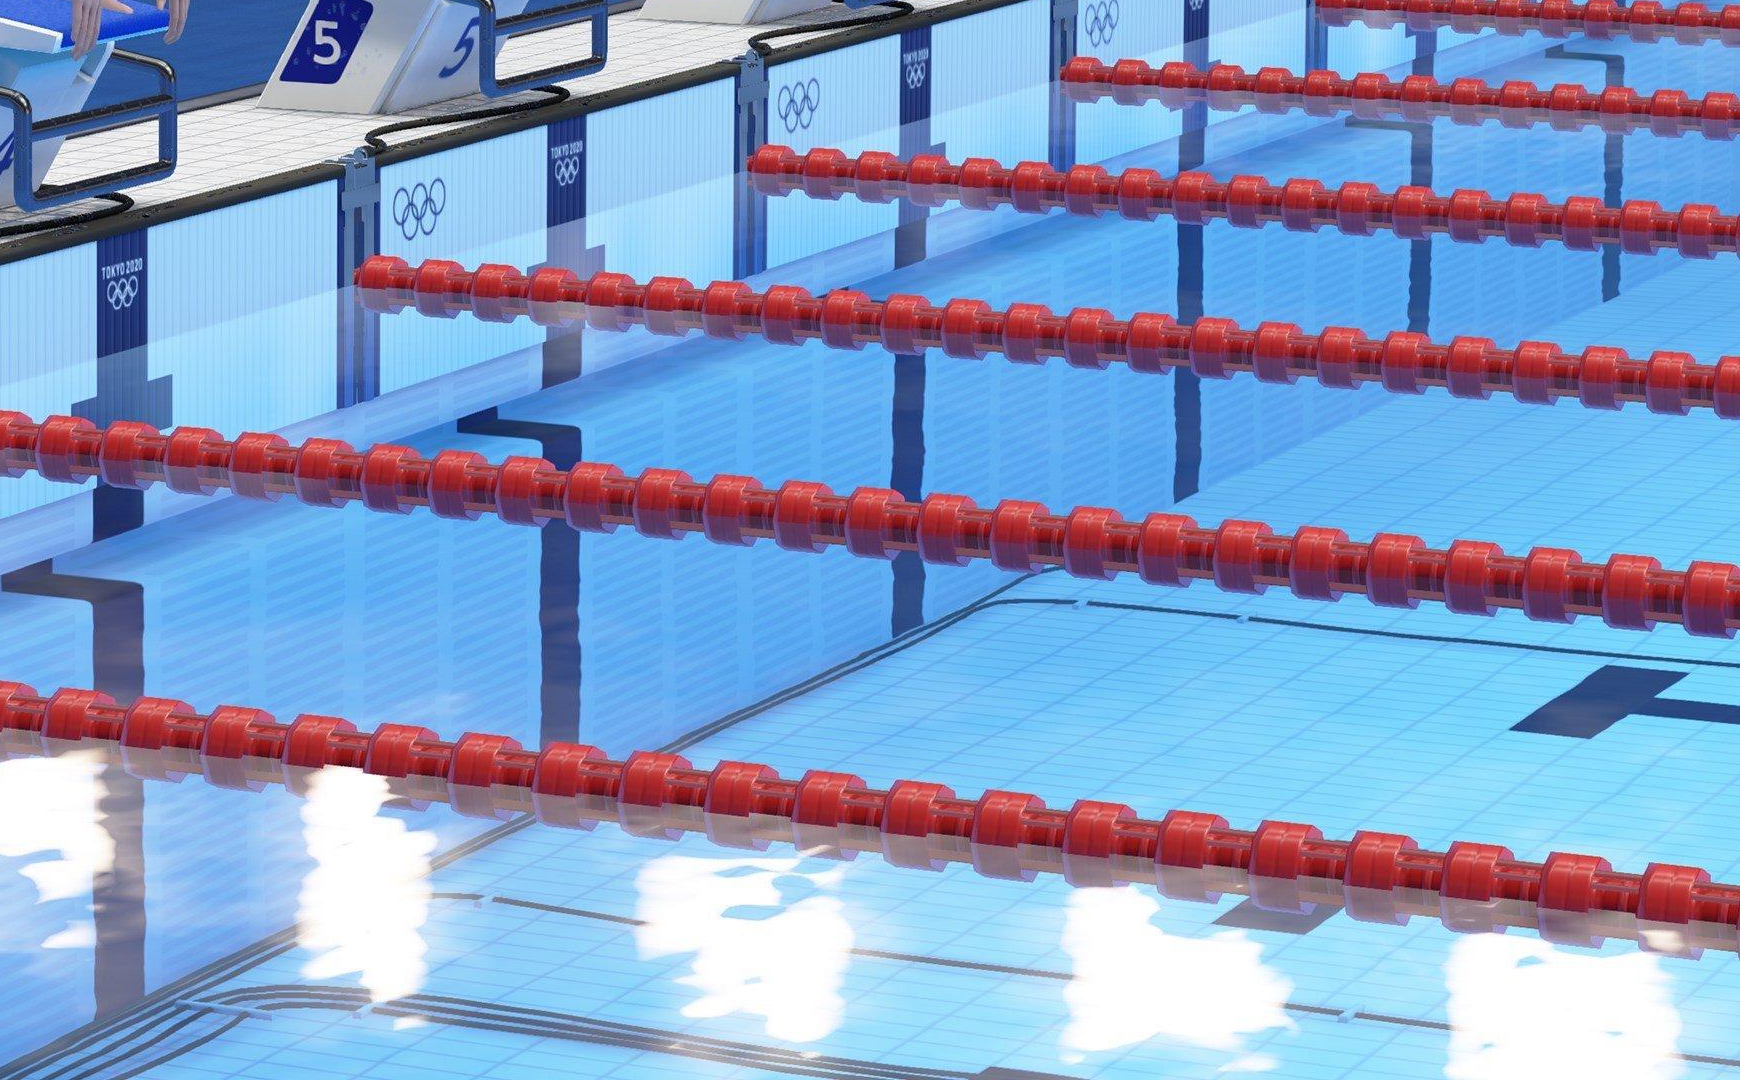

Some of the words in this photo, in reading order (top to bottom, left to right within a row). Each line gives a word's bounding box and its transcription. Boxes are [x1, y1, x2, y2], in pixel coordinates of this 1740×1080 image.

[313, 20, 342, 66] 5
[438, 15, 480, 79] 5
[101, 262, 125, 280] TOKYO
[126, 257, 143, 274] 2020
